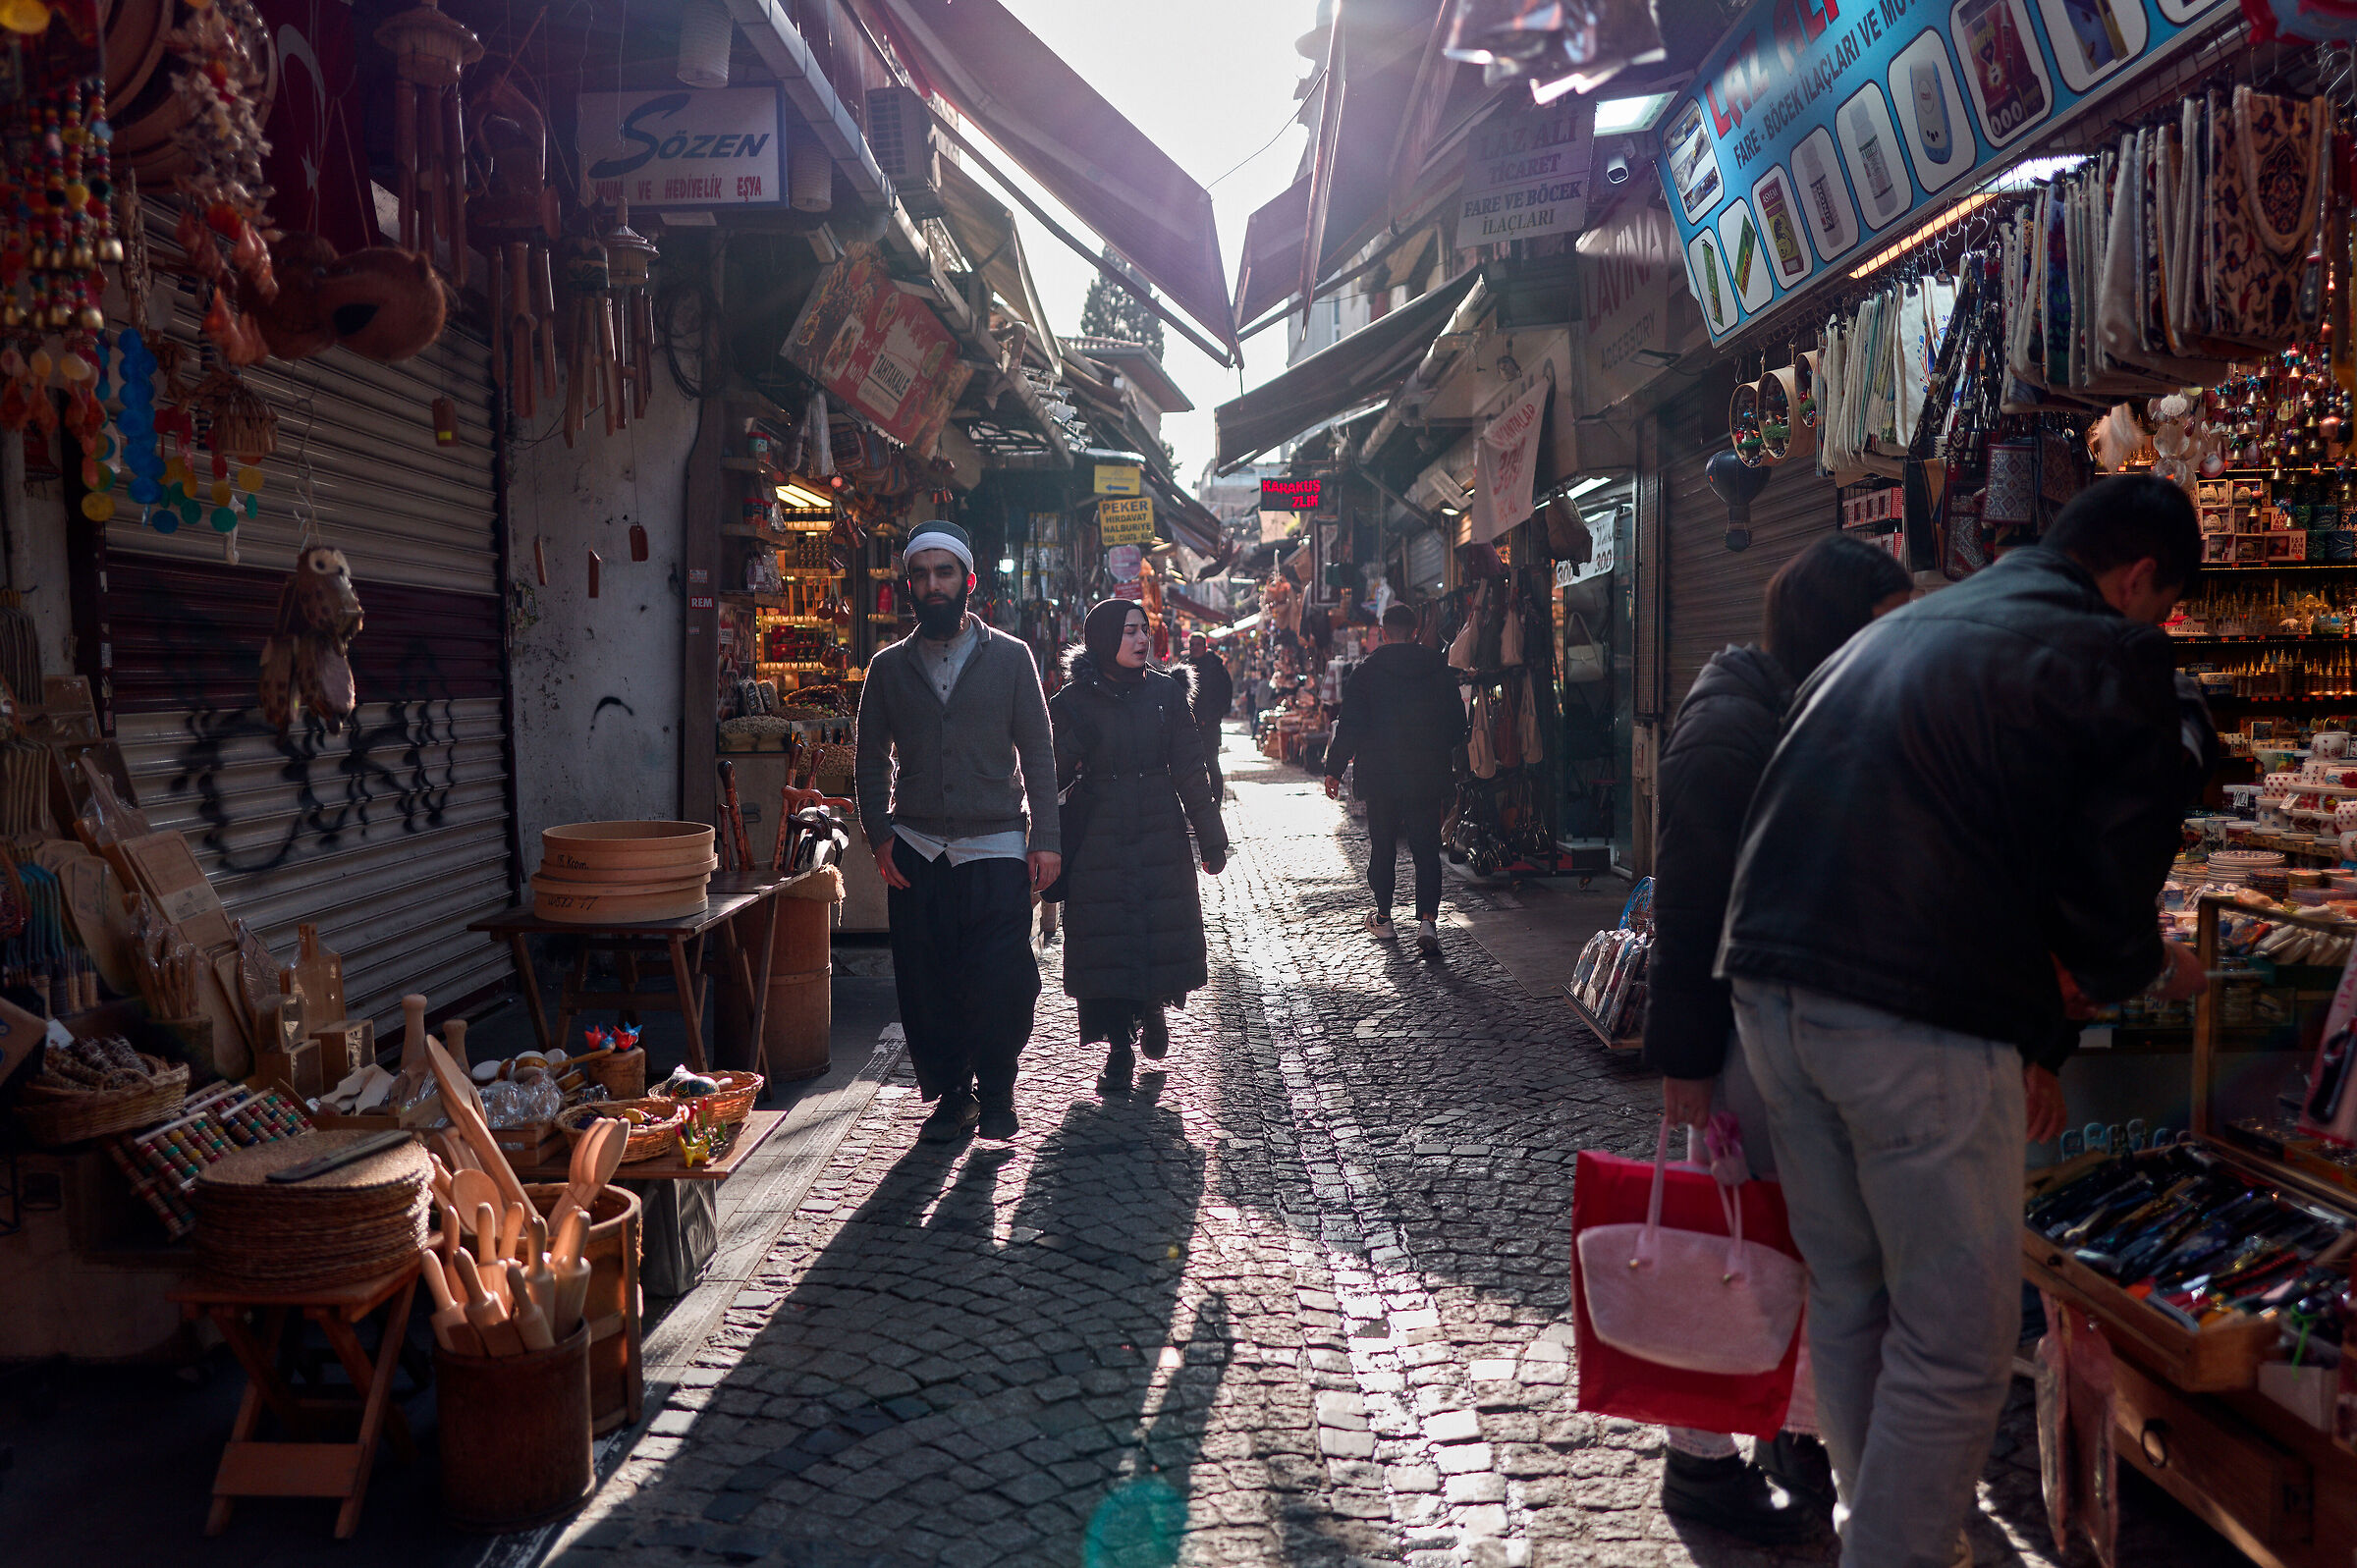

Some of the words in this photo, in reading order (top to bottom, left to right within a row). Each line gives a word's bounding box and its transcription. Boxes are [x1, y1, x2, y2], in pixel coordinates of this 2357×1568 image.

[1704, 29, 1770, 140] LAZ
[1733, 129, 1759, 169] FARE
[1764, 90, 1805, 141] BÖCEK
[1800, 28, 1861, 101] İLAÇLARI
[1857, 8, 1882, 47] VE
[588, 92, 771, 179] SÖZEN
[595, 180, 625, 201] MUM
[638, 180, 652, 200] VE
[664, 172, 723, 200] HEDİYELİK
[737, 175, 762, 202] EŞYA
[1463, 196, 1503, 218] FARE
[1505, 191, 1523, 211] VE
[1525, 181, 1582, 206] BÖCEK
[1482, 208, 1556, 236] İLAÇLARI
[872, 353, 911, 397] TAHTAKALE
[1102, 501, 1149, 514] PEKER
[1106, 513, 1147, 523] HIRDAVAT
[691, 597, 713, 608] REM
